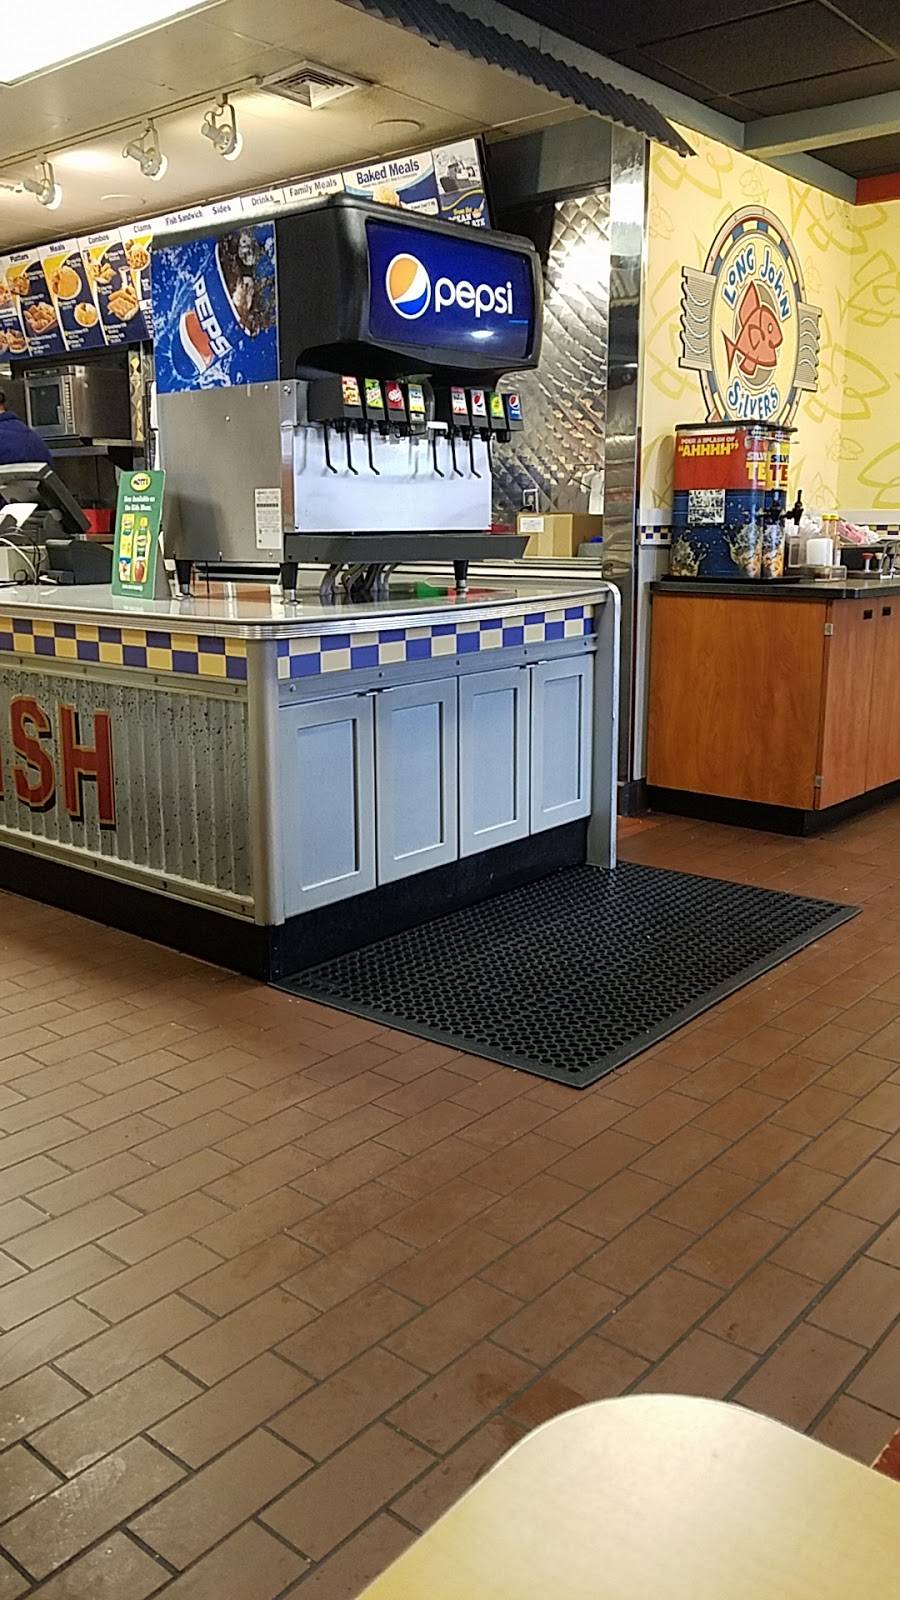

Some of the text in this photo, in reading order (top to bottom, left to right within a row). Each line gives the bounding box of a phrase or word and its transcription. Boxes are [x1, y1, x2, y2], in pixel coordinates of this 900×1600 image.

[356, 167, 387, 185] Baked
[388, 159, 420, 177] Meals
[289, 178, 338, 197] Family Meals
[251, 194, 275, 207] Drinks
[212, 204, 232, 215] Sides
[133, 224, 152, 233] Clams
[88, 234, 109, 244] Combos
[49, 244, 66, 252] Meals
[723, 247, 755, 305] LONG
[435, 277, 513, 318] pepsi
[0, 693, 117, 831] SH
